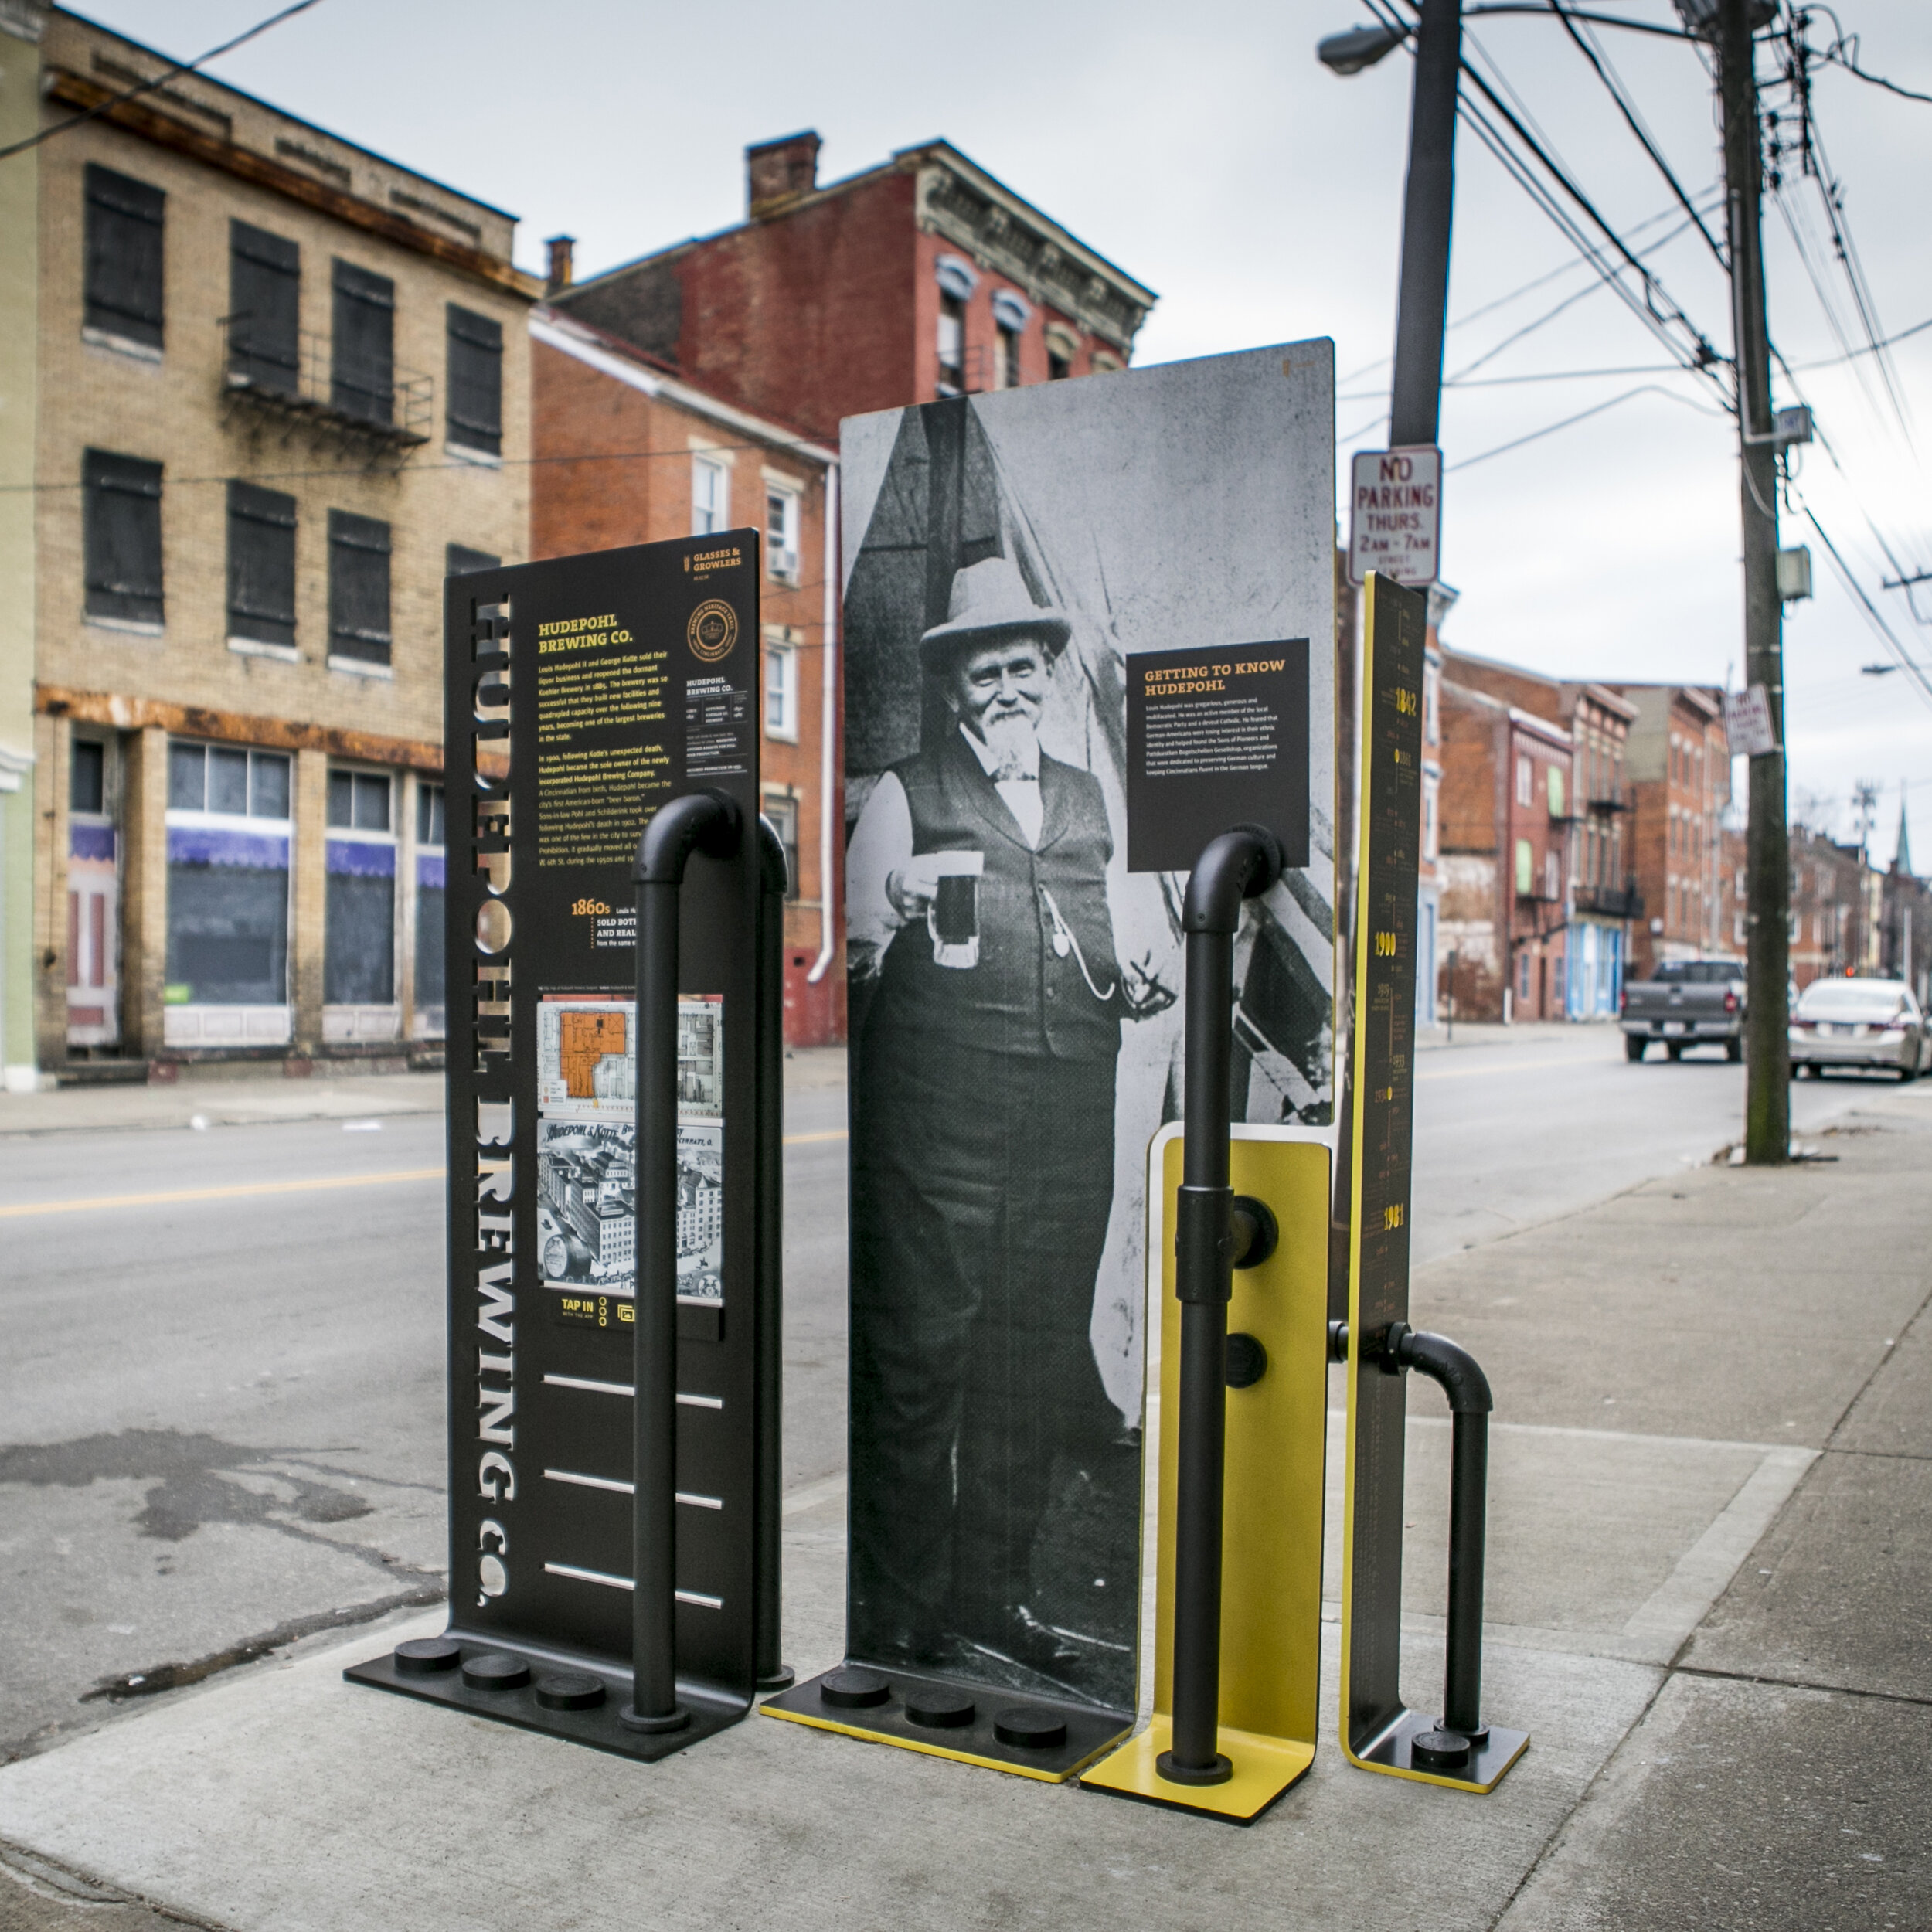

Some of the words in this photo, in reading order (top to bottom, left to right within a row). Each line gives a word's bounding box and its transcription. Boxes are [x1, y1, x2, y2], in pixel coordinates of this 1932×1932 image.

[1379, 457, 1413, 481] NO
[1358, 484, 1433, 510] PARKING
[1367, 512, 1424, 532] THURS.
[1360, 535, 1389, 553] 2AM
[1404, 534, 1430, 551] 7AM
[693, 548, 730, 562] GLASSES
[732, 547, 740, 556] &
[693, 557, 742, 572] GROWLERS
[704, 603, 728, 614] HERITAGE
[539, 614, 617, 636] HUDEPOHL
[539, 633, 607, 654] BREWING
[611, 630, 633, 644] CO.
[1145, 666, 1209, 682] GETTING
[1212, 664, 1231, 676] TO
[1235, 659, 1285, 675] KNOW
[686, 677, 725, 687] HUDEPOHL
[686, 686, 721, 696] BREWING
[1145, 679, 1225, 696] HUDEPOHL
[1395, 686, 1416, 717] 1842
[471, 592, 512, 1073] HUDEPOHL
[572, 898, 610, 916] 1860s
[597, 918, 616, 927] SOLD
[1374, 931, 1396, 957] 1900
[546, 1124, 587, 1141] HUDEPOHL
[587, 1126, 594, 1137] &
[591, 1124, 619, 1140] KOTTE
[678, 1138, 705, 1146] CINNATI,
[1383, 1202, 1404, 1230] 1981
[476, 1095, 515, 1503] BREWING
[561, 1298, 580, 1310] TAP
[582, 1301, 594, 1312] IN
